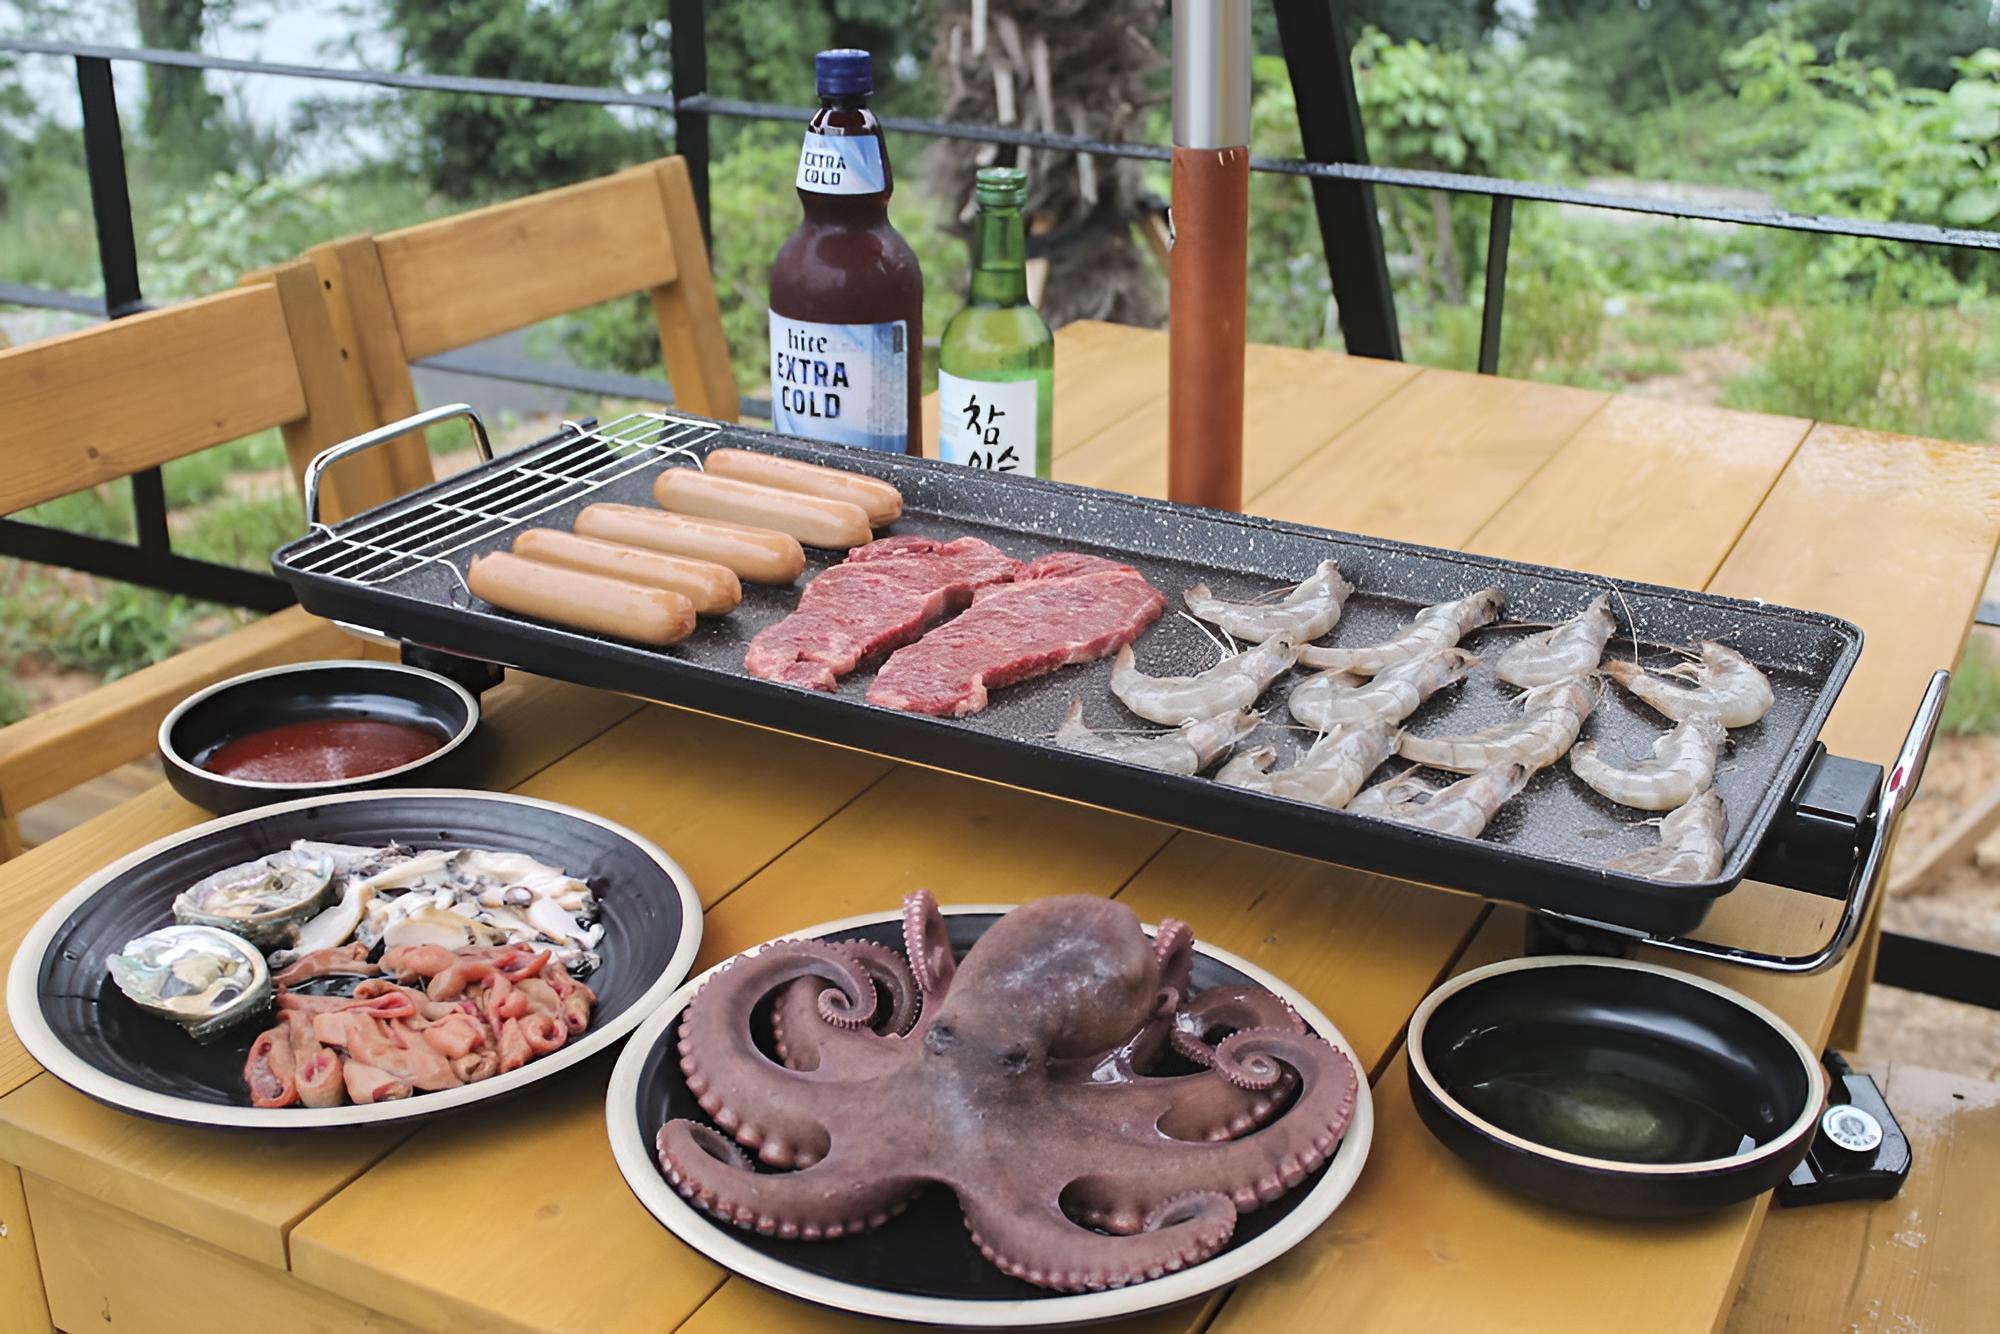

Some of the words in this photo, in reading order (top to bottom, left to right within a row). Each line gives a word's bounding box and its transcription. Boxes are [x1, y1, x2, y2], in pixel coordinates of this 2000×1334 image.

[805, 151, 847, 170] EXTRA
[805, 168, 841, 185] COLD
[777, 352, 849, 388] EXTRA
[782, 385, 841, 419] COLD
[963, 394, 1006, 446] 참
